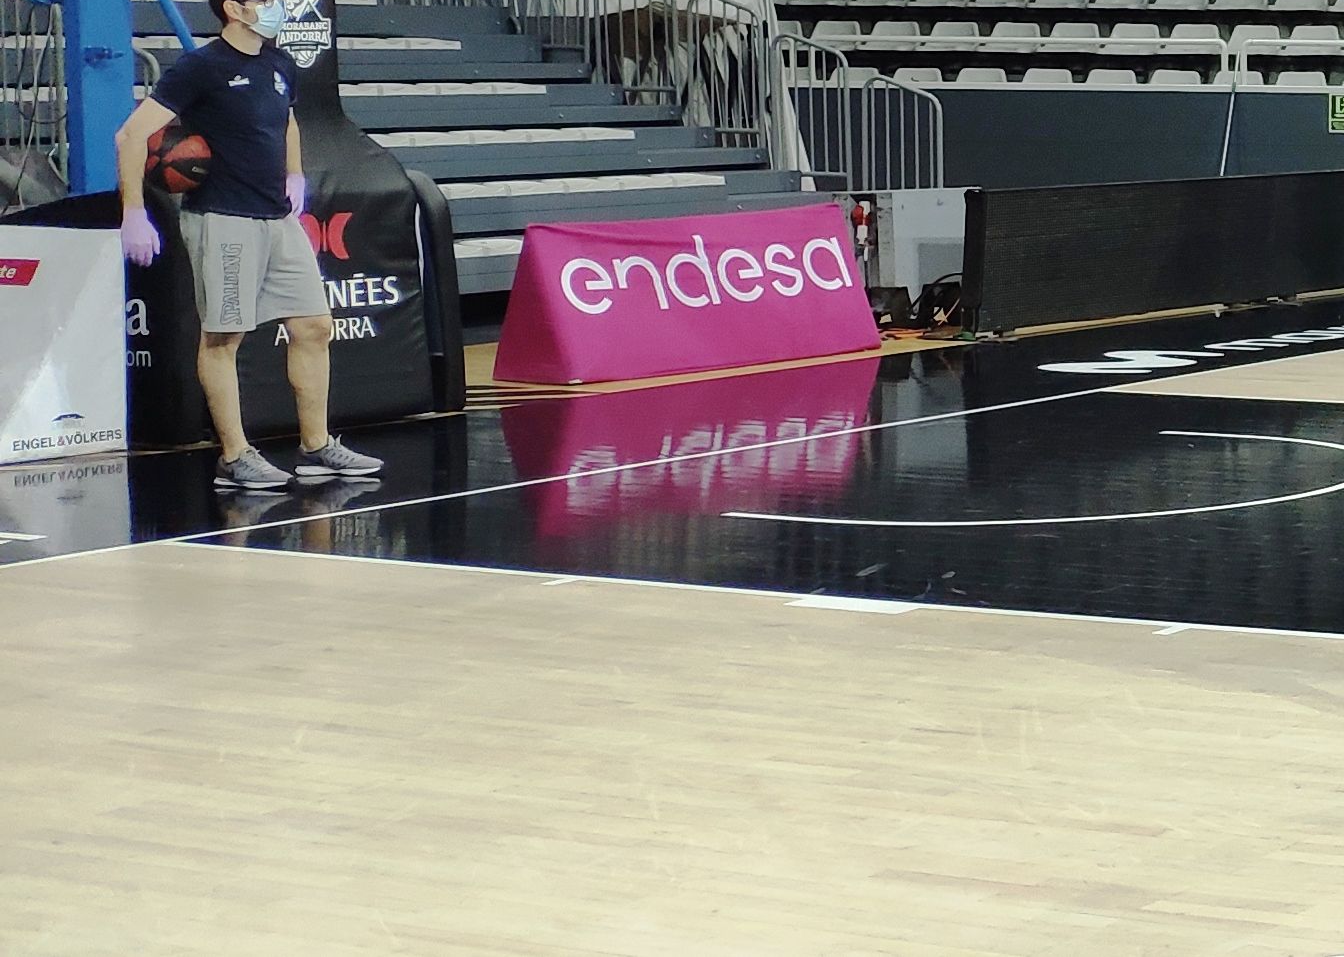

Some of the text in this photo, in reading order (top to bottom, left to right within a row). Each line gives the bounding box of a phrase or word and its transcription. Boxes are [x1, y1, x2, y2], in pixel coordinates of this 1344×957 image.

[280, 31, 328, 44] ANDORRA
[220, 243, 243, 325] SPALDING
[560, 234, 853, 315] endesa
